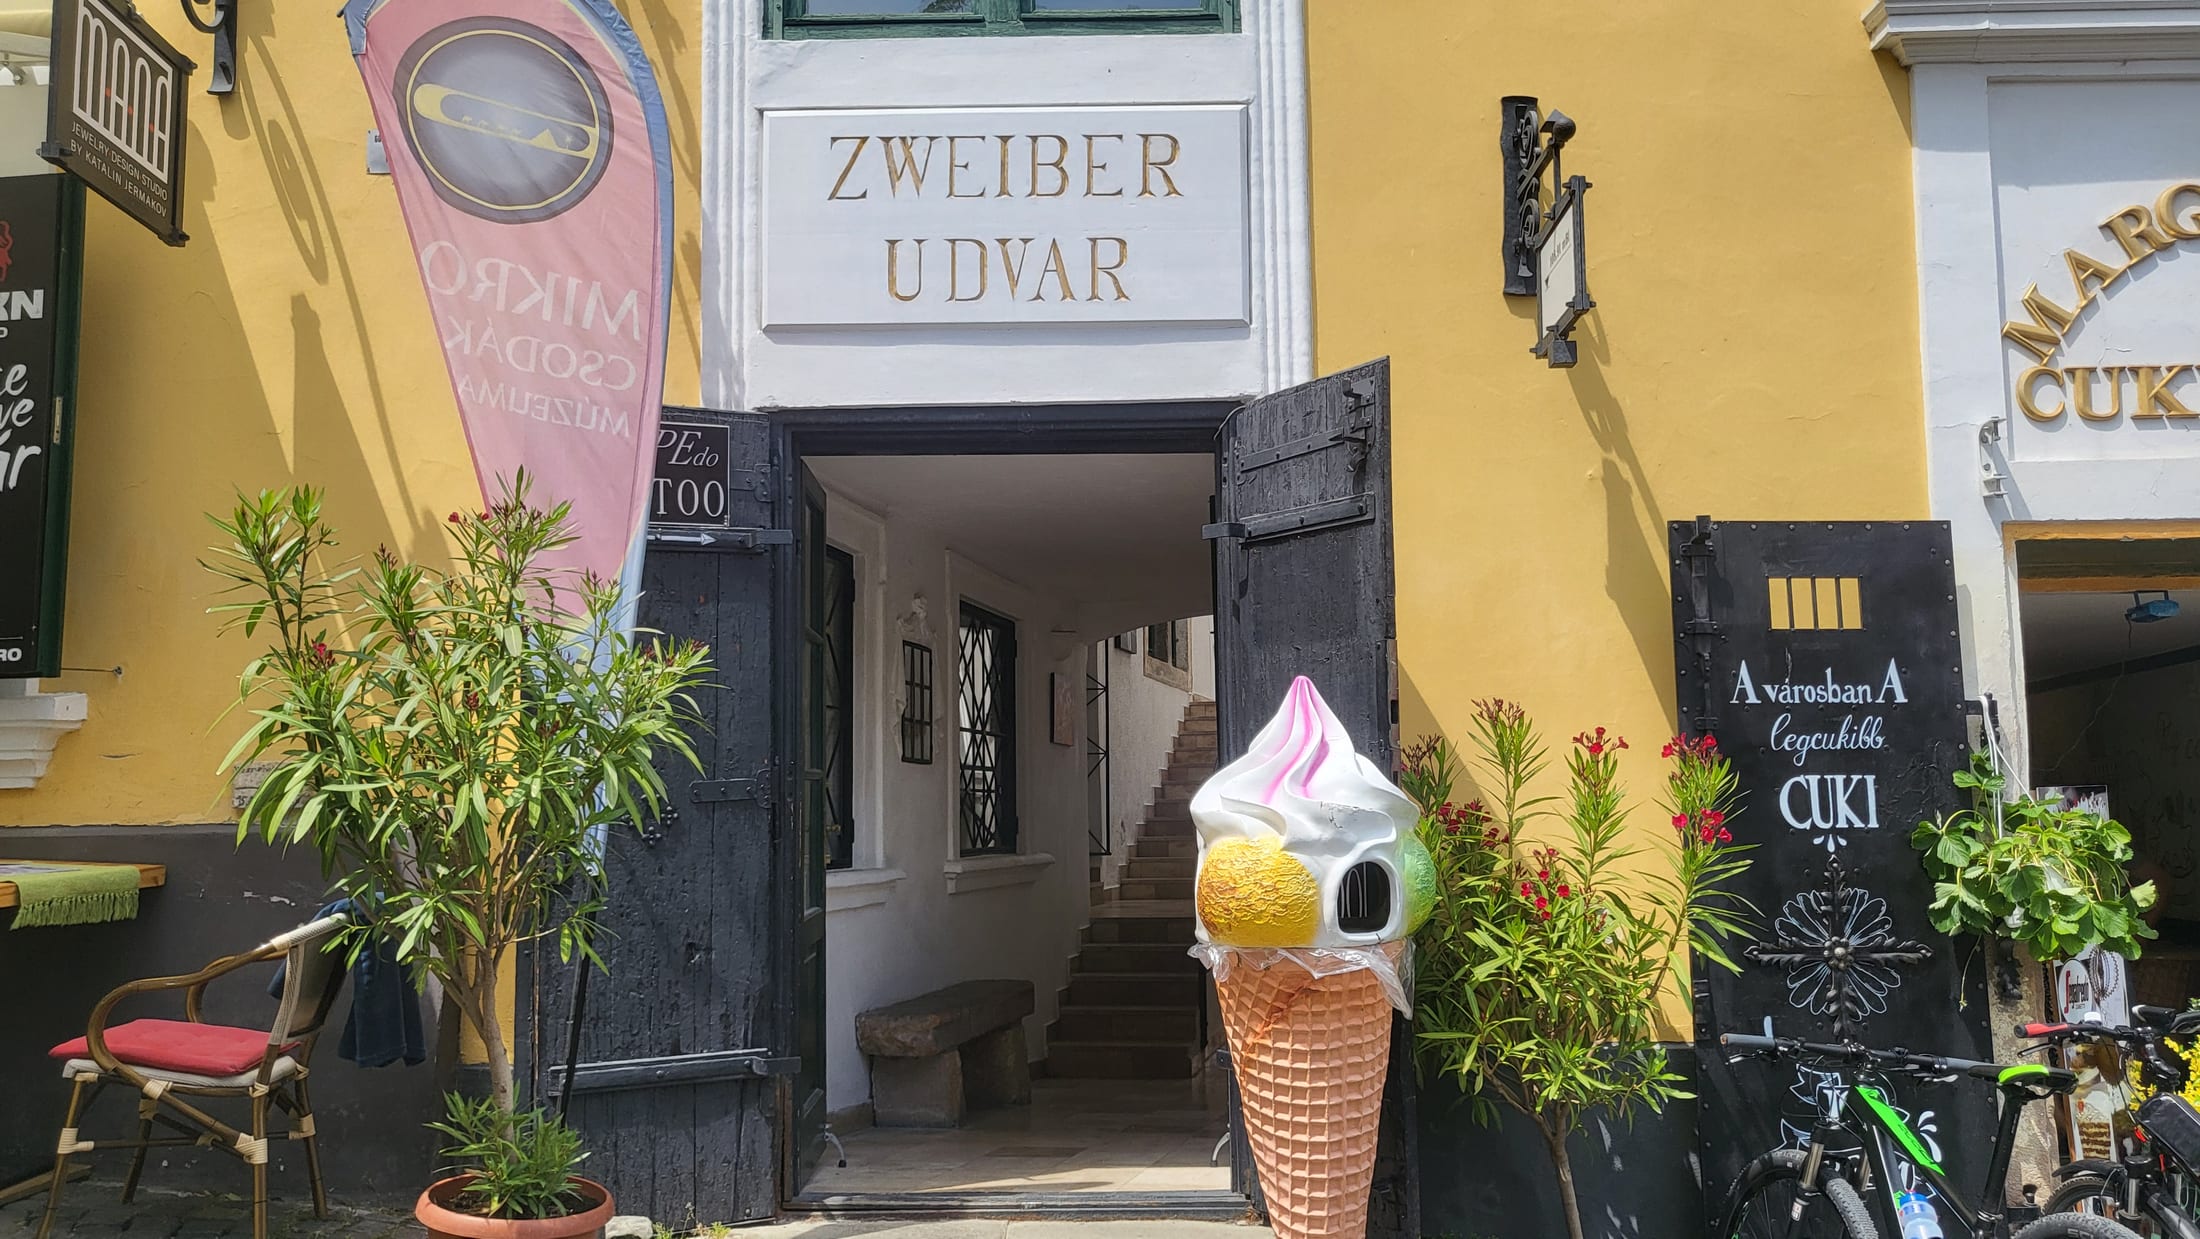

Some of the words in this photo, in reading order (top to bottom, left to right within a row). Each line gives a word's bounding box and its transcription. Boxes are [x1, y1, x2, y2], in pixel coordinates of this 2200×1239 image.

[70, 138, 83, 156] BY
[85, 149, 122, 186] KATALIN
[124, 180, 167, 217] JERMAKOV
[72, 121, 110, 158] JEWELRY
[111, 150, 140, 181] DESIGN
[141, 173, 168, 201] STUDIO
[827, 133, 1184, 200] ZWEIBER
[884, 237, 1132, 302] UDVAR
[2015, 364, 2200, 422] CUK
[1729, 659, 1762, 704] A
[1875, 657, 1908, 703] A
[1770, 713, 1886, 766] legcukibb
[1778, 774, 1880, 830] CUKI
